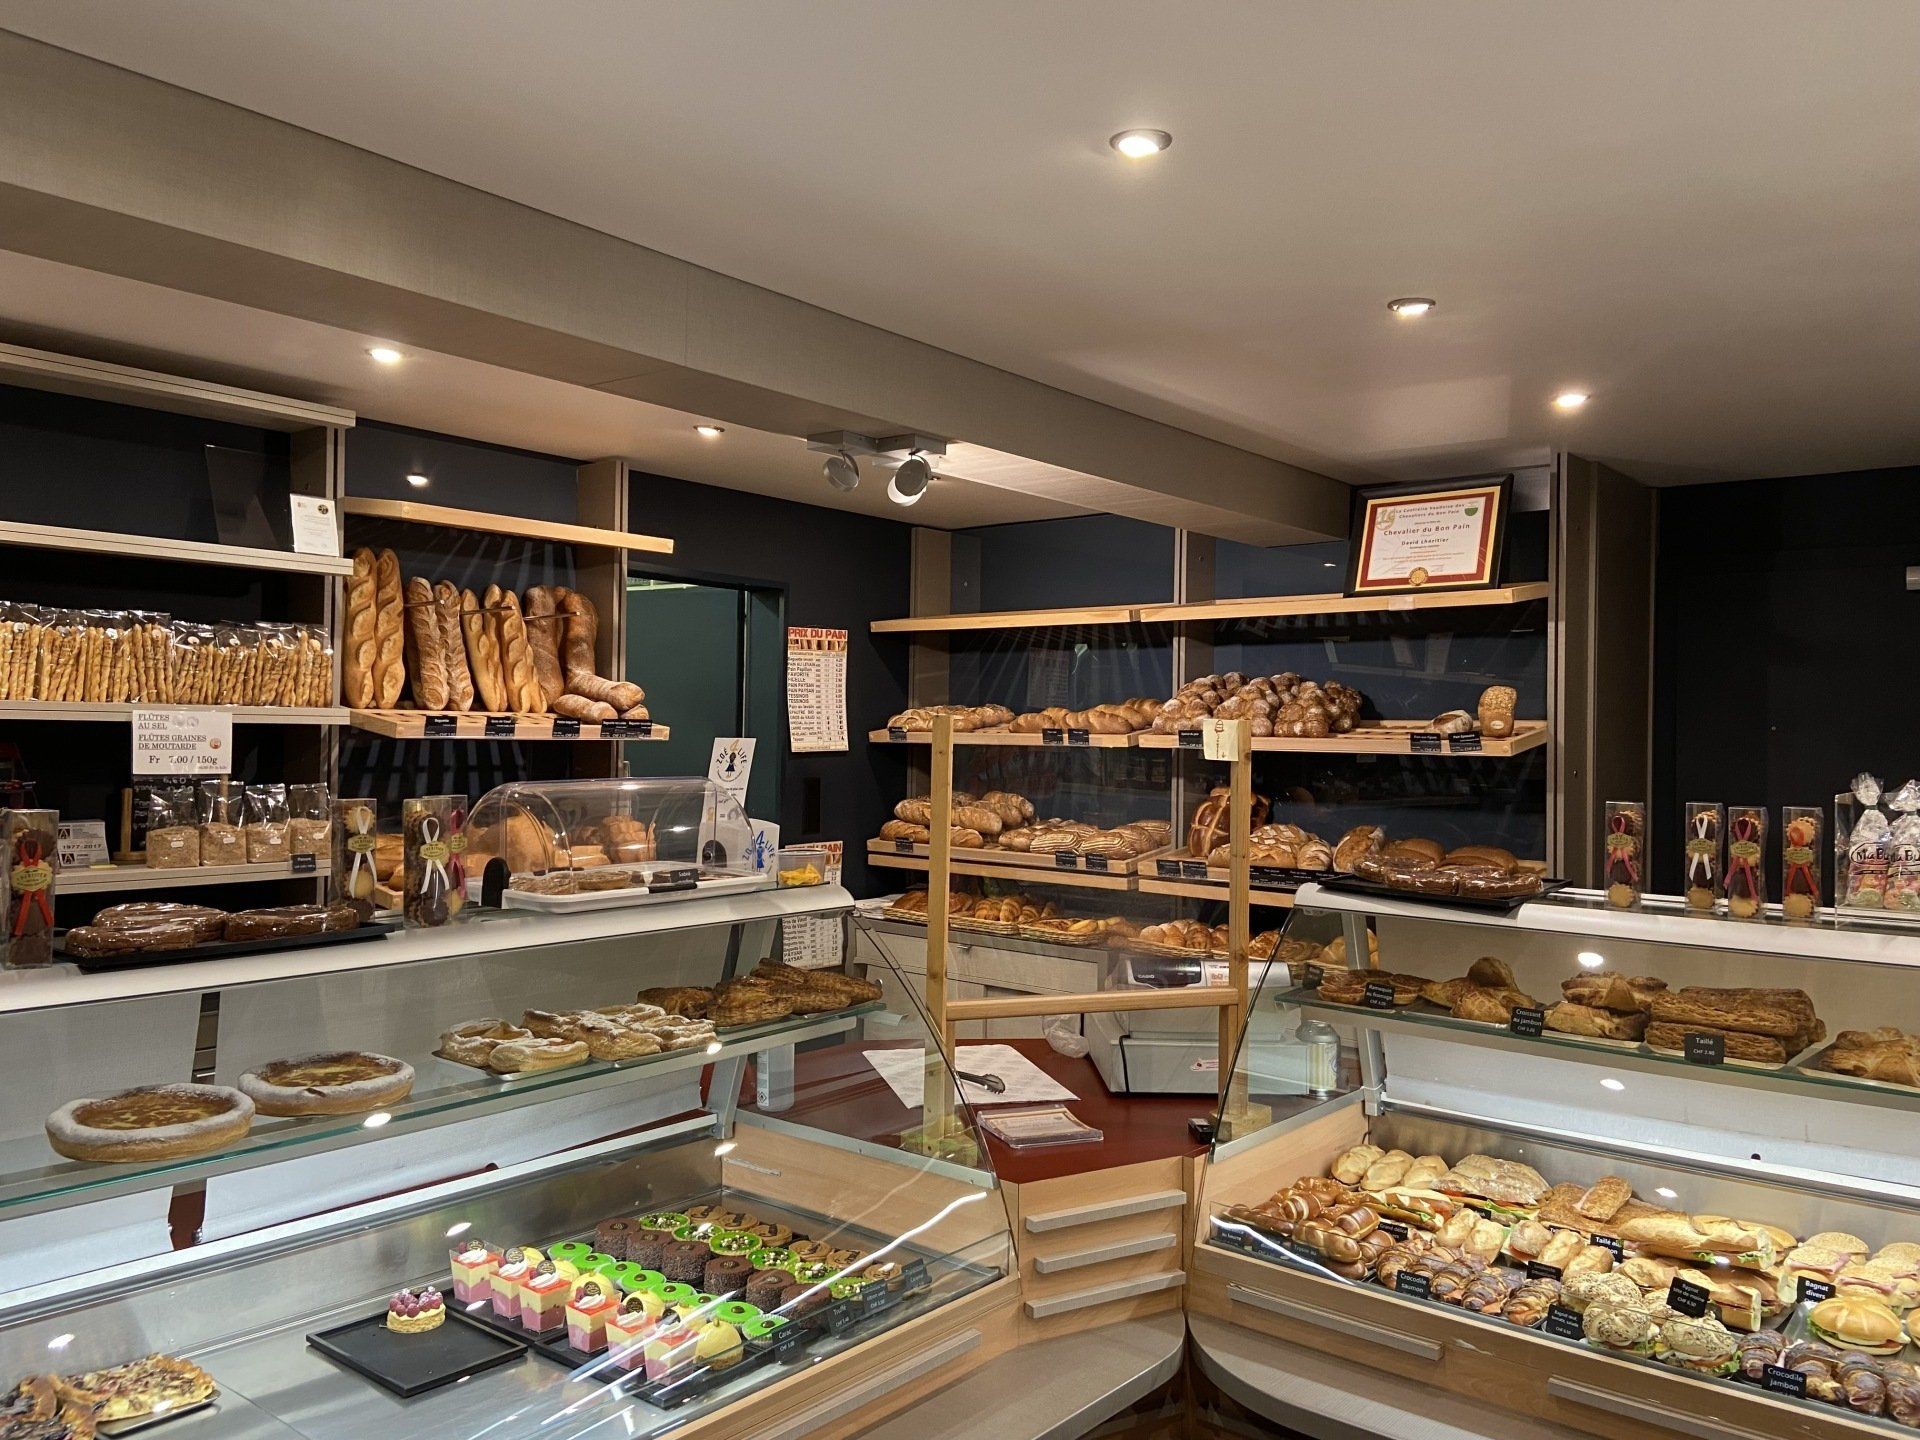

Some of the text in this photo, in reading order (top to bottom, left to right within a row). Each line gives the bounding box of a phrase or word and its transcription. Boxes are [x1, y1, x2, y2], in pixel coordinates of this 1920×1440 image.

[1384, 527, 1420, 536] Chevalier
[1452, 523, 1470, 531] Pain
[788, 628, 846, 640] PRIX DU PAIN
[138, 712, 170, 721] FLÛTES
[138, 733, 170, 742] FLÛTES
[149, 756, 160, 764] Fr
[196, 756, 218, 765] 150g
[737, 748, 747, 764] LIFE
[756, 831, 764, 845] 4
[765, 840, 775, 858] LIFE
[1516, 1009, 1541, 1018] Croissant
[1400, 1273, 1426, 1284] Crocodile
[1402, 1283, 1424, 1293] saumon
[1805, 1281, 1829, 1292] Bagnat
[1806, 1290, 1826, 1299] divers
[778, 1328, 791, 1339] Carac
[1768, 1368, 1803, 1382] Crocodile
[1770, 1380, 1799, 1391] jambon
